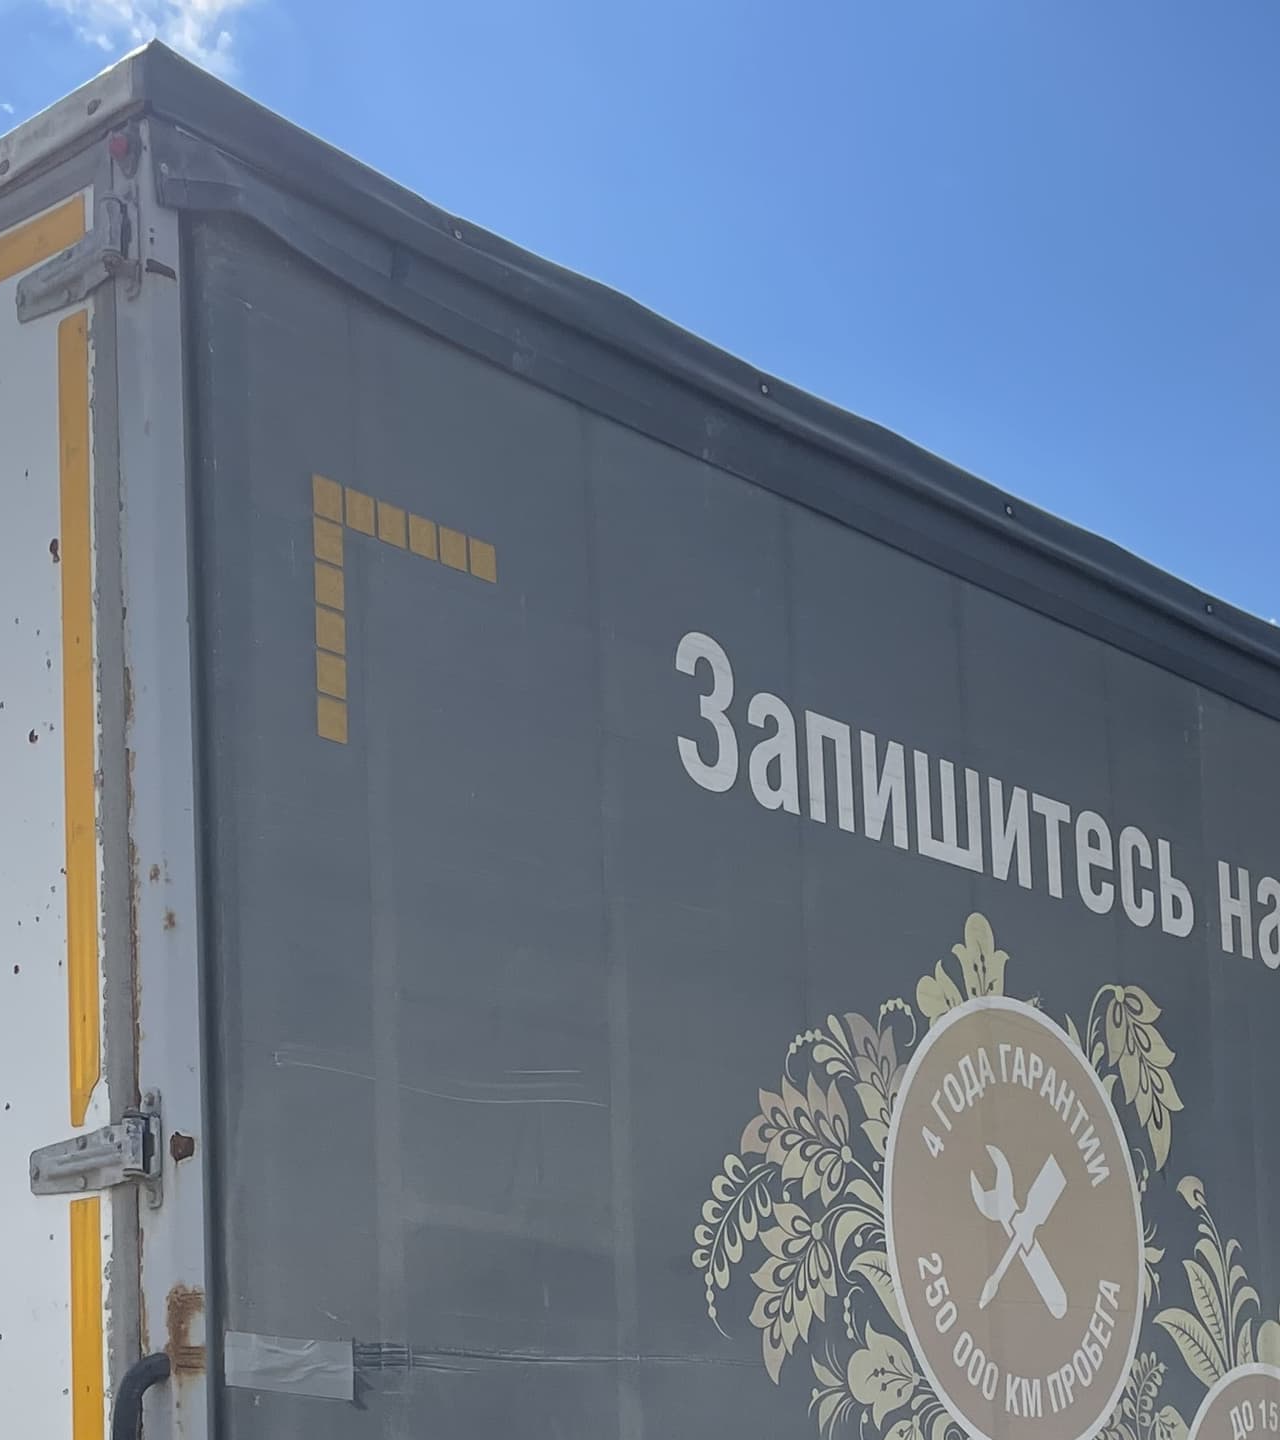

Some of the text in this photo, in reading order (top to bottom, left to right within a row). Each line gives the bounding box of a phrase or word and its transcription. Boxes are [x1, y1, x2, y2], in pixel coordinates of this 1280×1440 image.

[675, 631, 1195, 938] Запишитесь
[920, 1043, 1111, 1188] 4 ГОДА ГАРАНТИИ
[917, 1252, 1121, 1418] 250 000 КМ ПРОБЕГА
